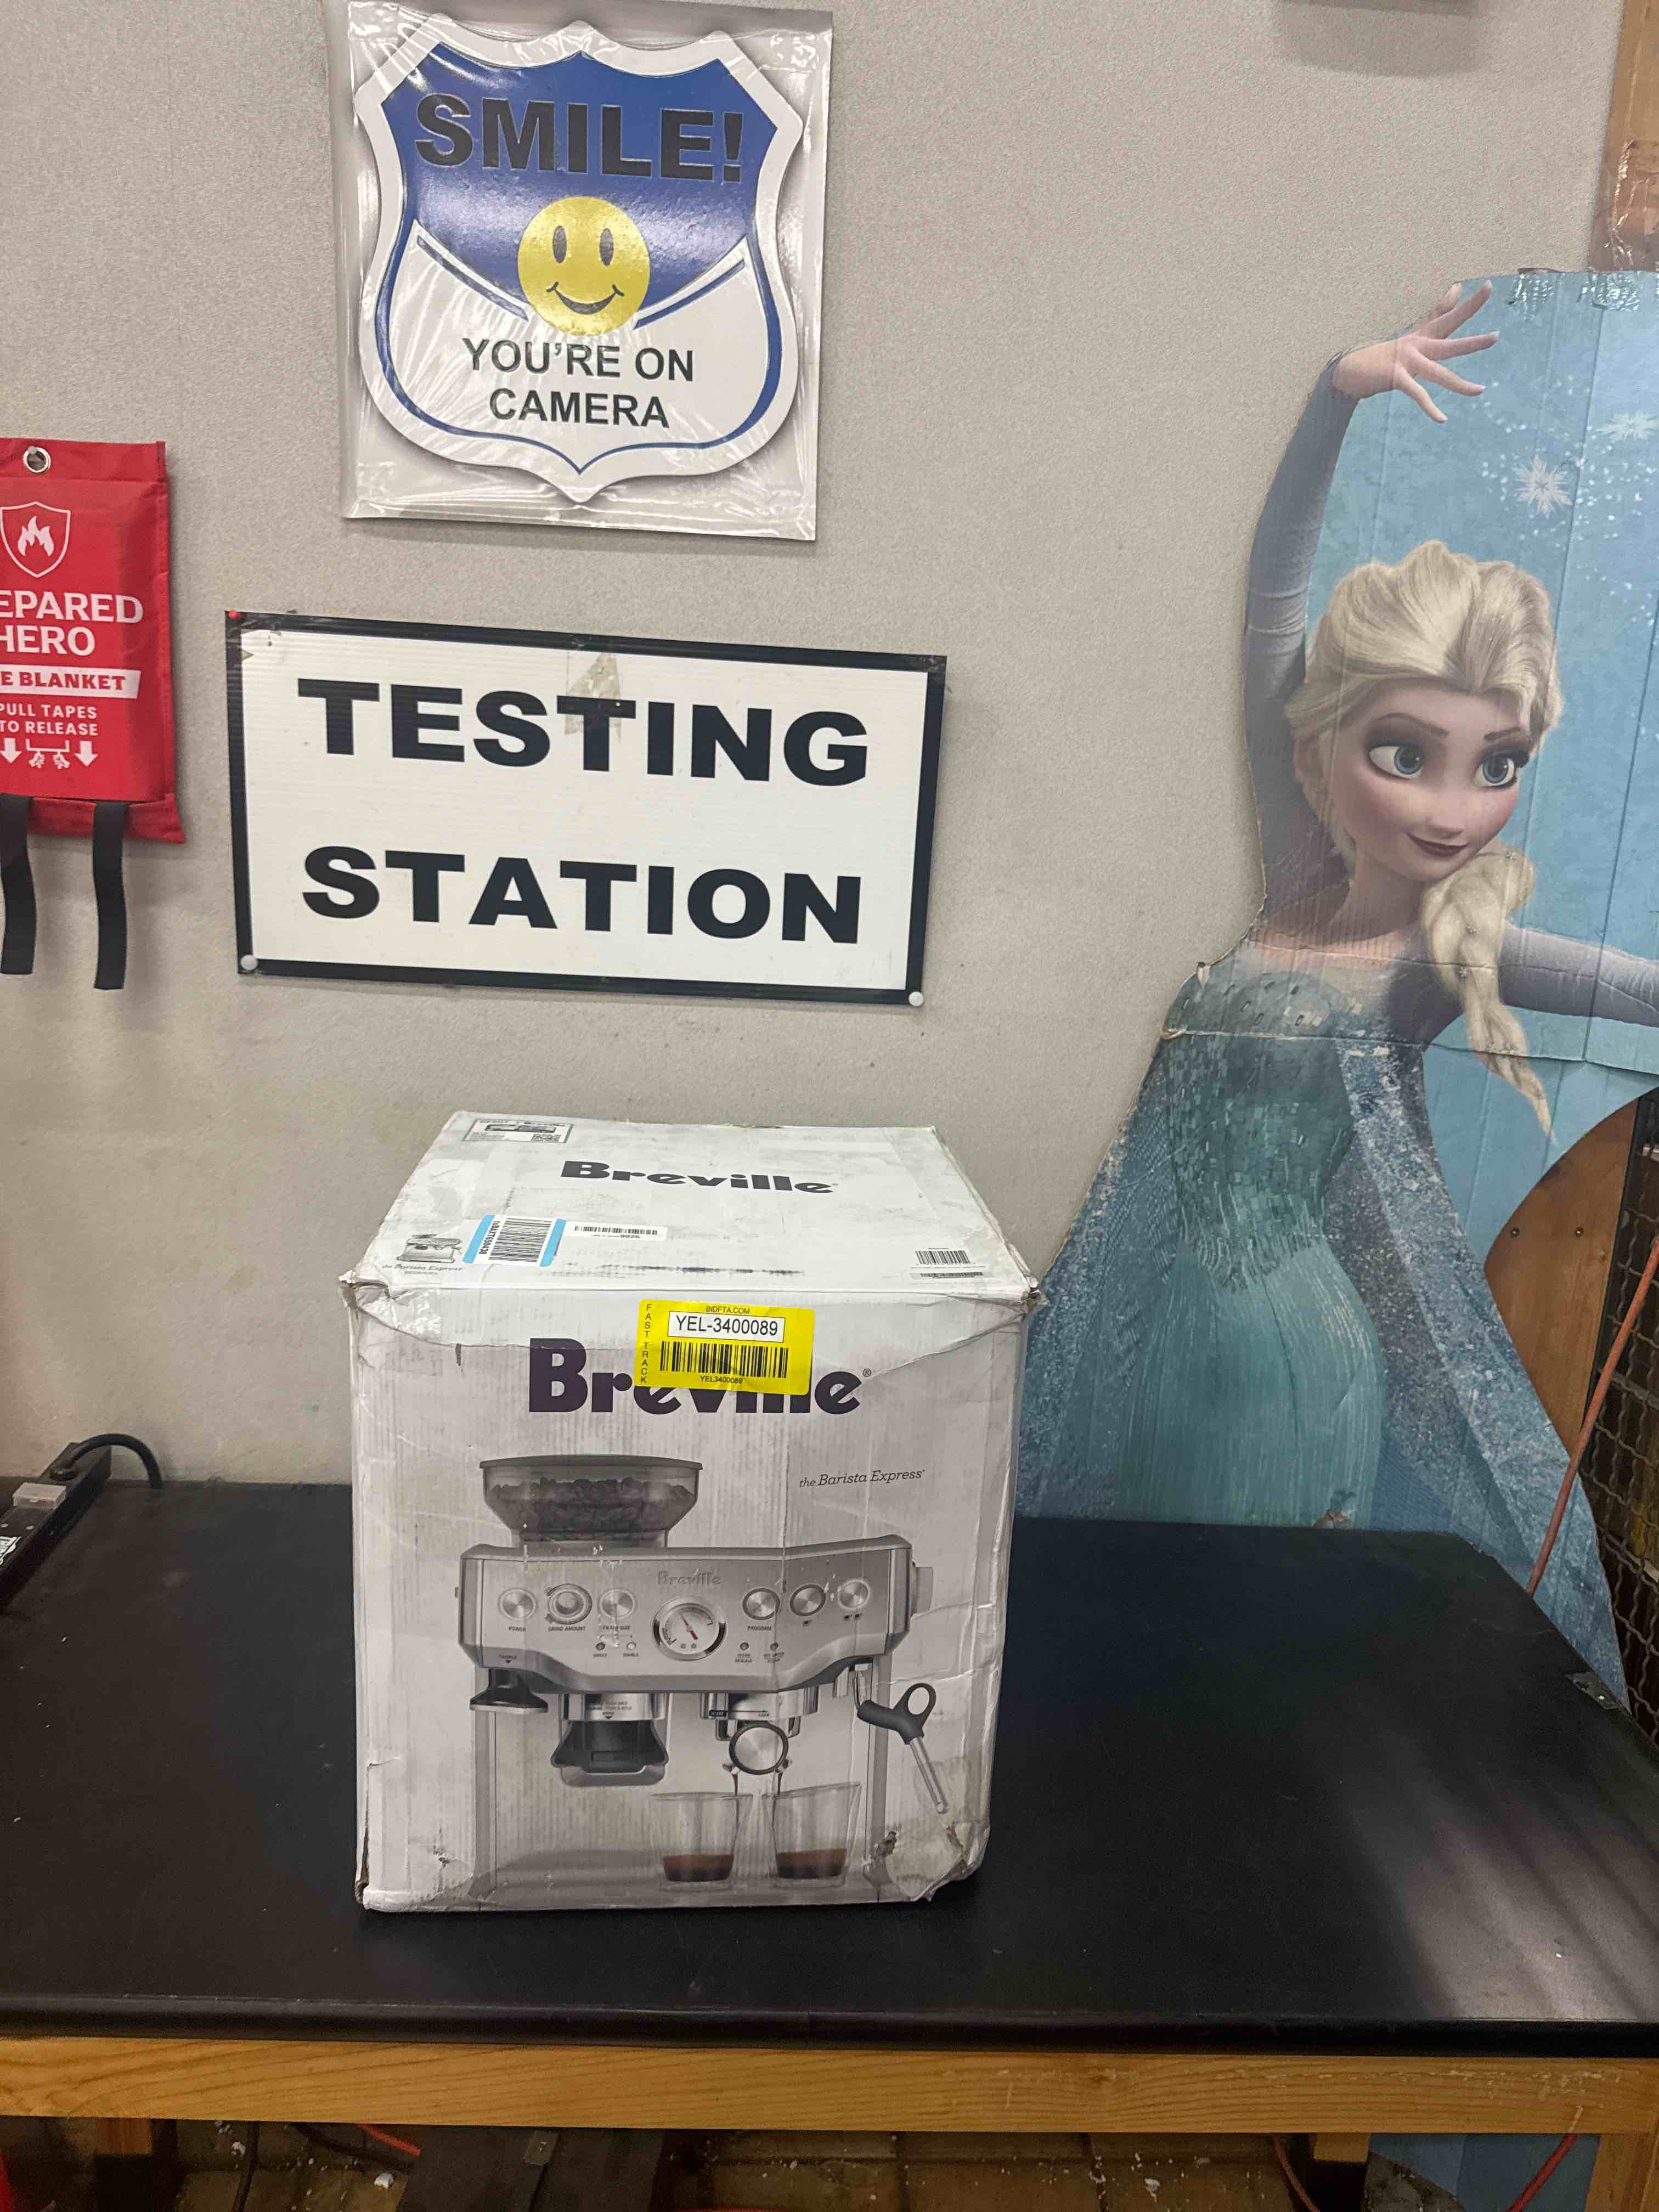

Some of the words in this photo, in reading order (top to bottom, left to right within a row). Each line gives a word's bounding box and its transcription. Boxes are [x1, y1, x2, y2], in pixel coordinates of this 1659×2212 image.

[415, 92, 743, 182] SMILE!
[463, 337, 620, 379] YOU'RE
[635, 347, 694, 382] ON
[488, 388, 669, 428] CAMERA
[0, 624, 95, 656] HERO
[19, 672, 126, 690] BLANKET
[41, 704, 97, 719] TAPES
[0, 720, 20, 733] TO
[25, 720, 98, 736] RELEASE
[297, 678, 868, 787] TESTING
[302, 845, 862, 944] STATION
[561, 1160, 833, 1193] Breville
[675, 1314, 778, 1336] YEL-3400089
[706, 1306, 751, 1314] BIDFTA.COM
[529, 1338, 862, 1415] Breve
[640, 1342, 650, 1383] TRACK
[699, 1375, 743, 1384] YEL3400089
[799, 1477, 816, 1488] the
[817, 1473, 867, 1486] Barista
[870, 1470, 922, 1484] Express
[658, 1571, 721, 1585] Breville
